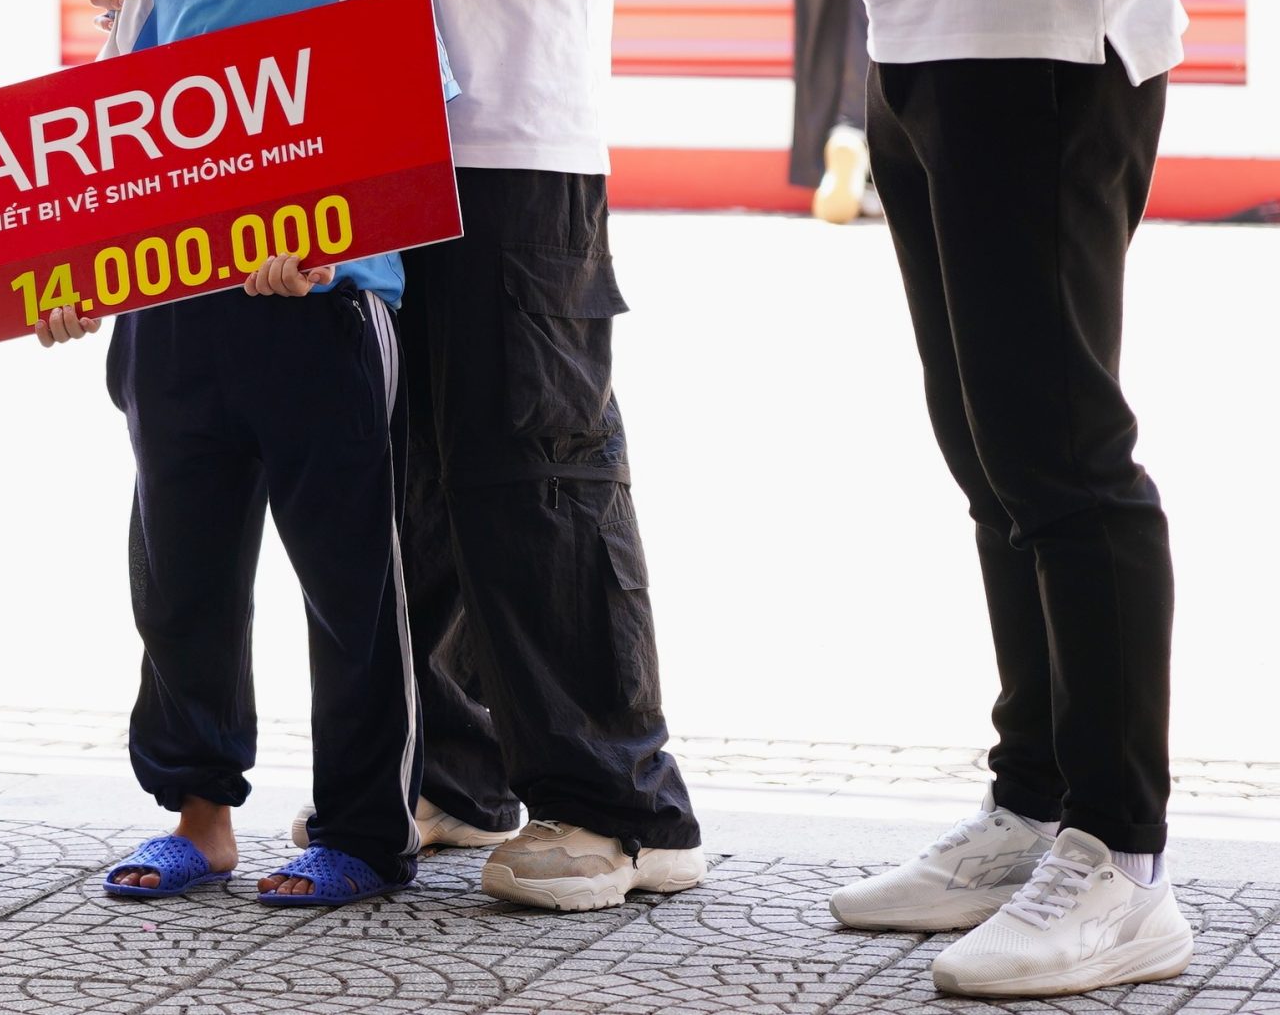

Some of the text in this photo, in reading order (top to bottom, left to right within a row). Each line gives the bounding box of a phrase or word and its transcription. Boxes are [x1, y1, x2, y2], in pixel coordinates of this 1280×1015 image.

[38, 200, 61, 223] BỊ
[67, 186, 100, 214] VỆ
[106, 175, 161, 204] SINH
[167, 154, 254, 189] THÔNG
[261, 136, 324, 168] MINH
[10, 194, 353, 326] 14.000.000
